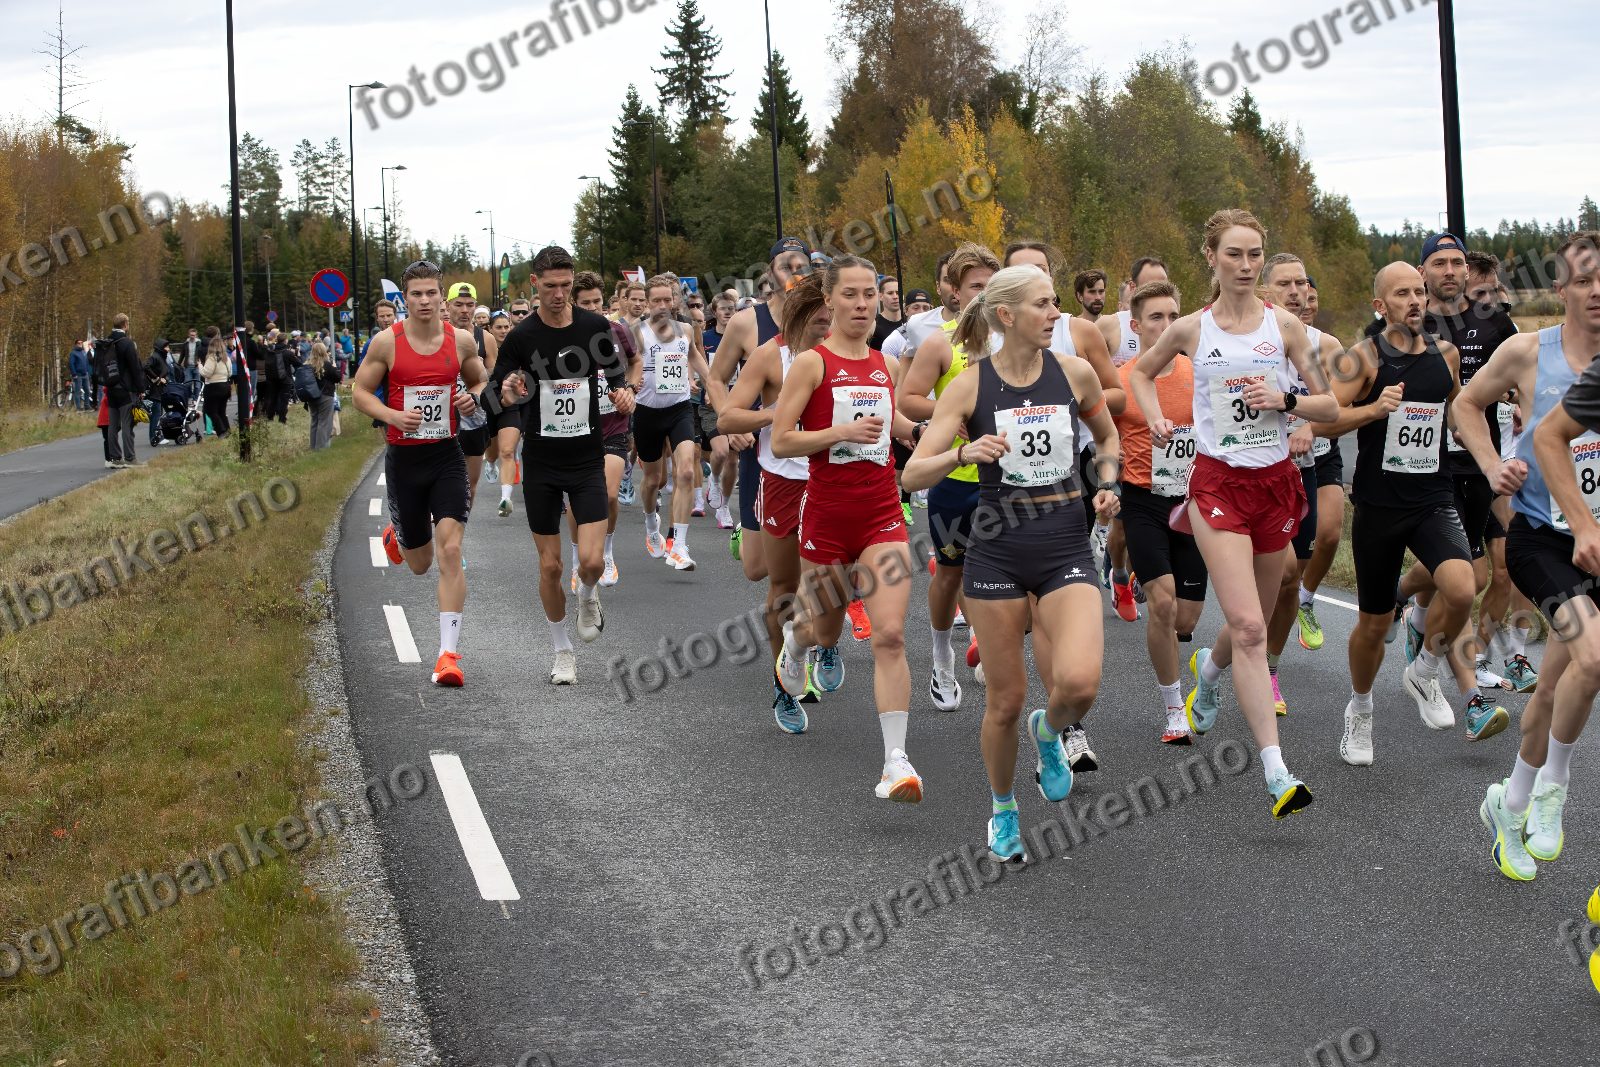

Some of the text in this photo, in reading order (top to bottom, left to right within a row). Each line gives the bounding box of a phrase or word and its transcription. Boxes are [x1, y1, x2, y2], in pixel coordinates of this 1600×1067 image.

[662, 365, 682, 379] 543
[849, 392, 883, 400] NORGES
[554, 398, 576, 416] 20
[851, 399, 878, 407] LØPET
[413, 404, 442, 422] 92
[1012, 405, 1058, 417] NORGES
[1404, 406, 1439, 415] NORGES
[1017, 414, 1051, 425] LØPET
[1405, 413, 1434, 422] LØPET
[1173, 427, 1192, 435] ØPET
[1243, 429, 1278, 441] Aurskog
[1398, 425, 1434, 449] 640
[1020, 429, 1052, 458] 33
[1165, 438, 1196, 459] 780
[1031, 467, 1070, 479] Aursko
[1581, 467, 1600, 495] 8
